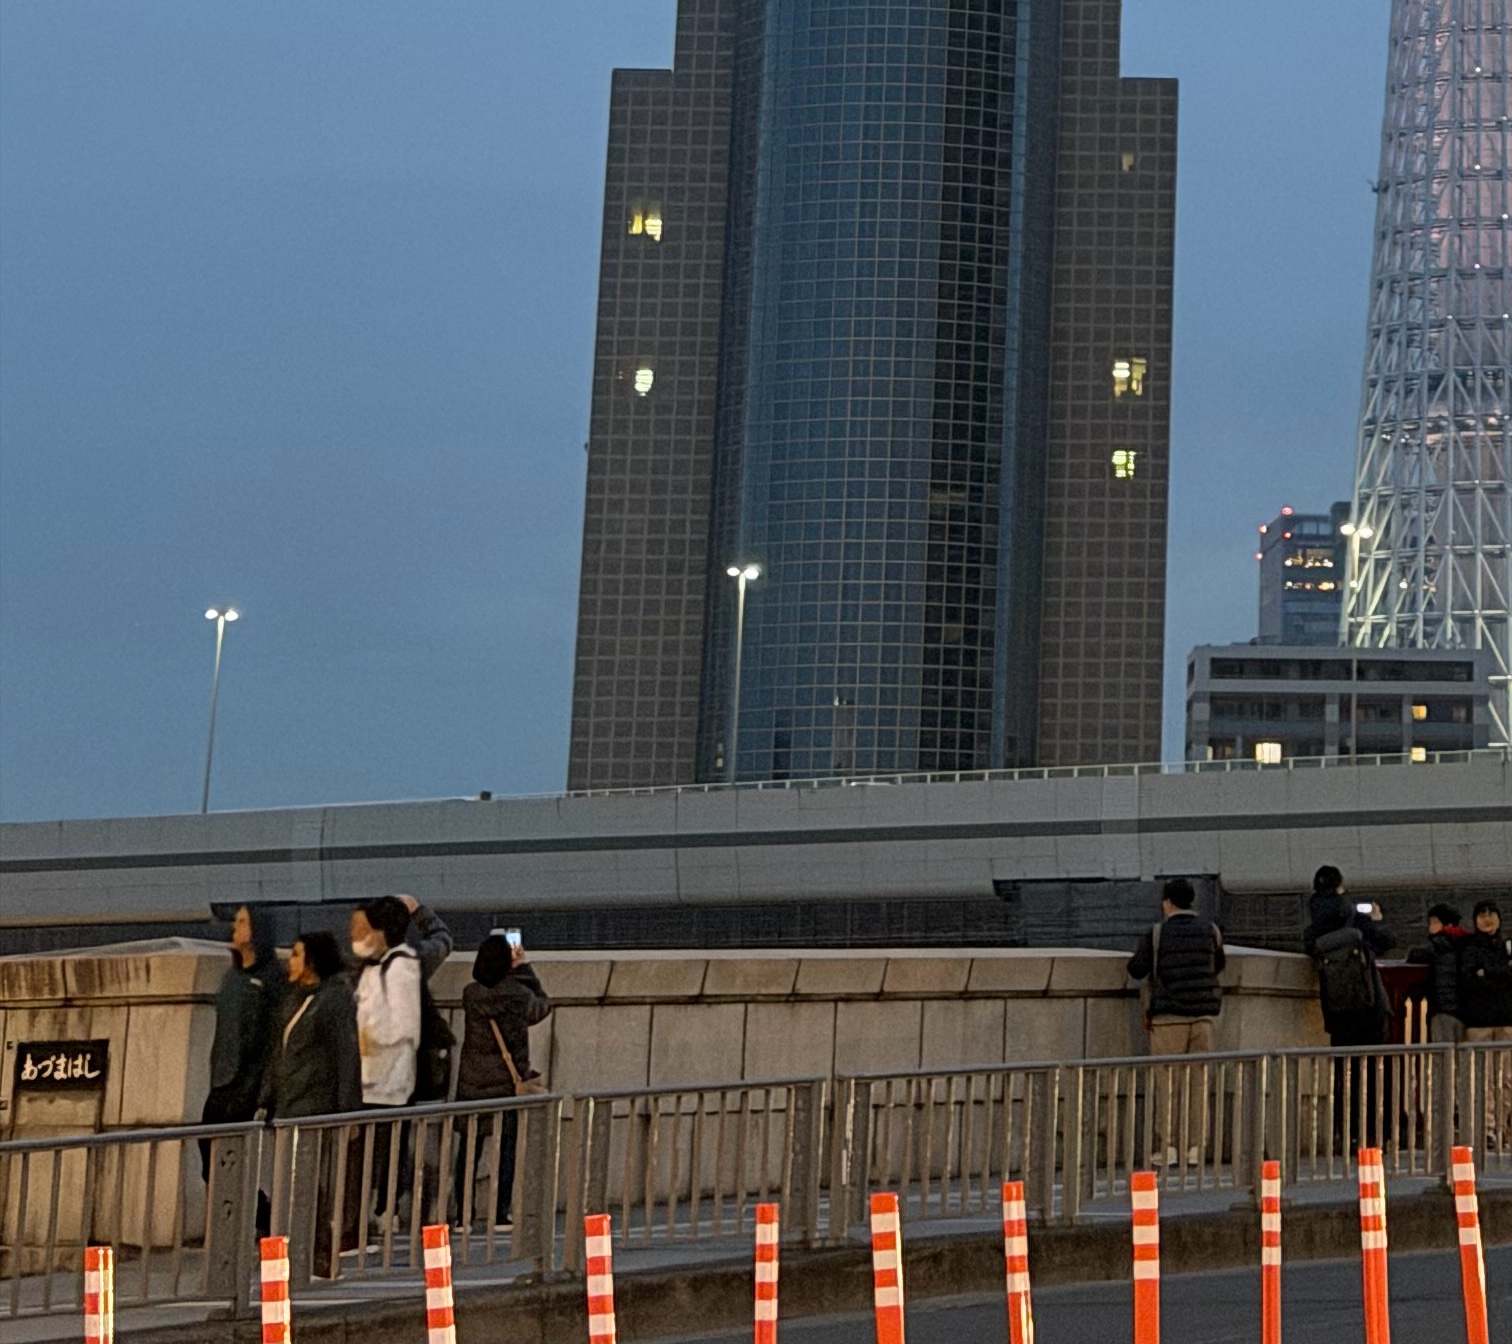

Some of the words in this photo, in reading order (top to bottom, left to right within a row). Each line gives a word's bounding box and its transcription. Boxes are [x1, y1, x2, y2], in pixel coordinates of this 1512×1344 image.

[21, 1053, 100, 1080] あづまはし
